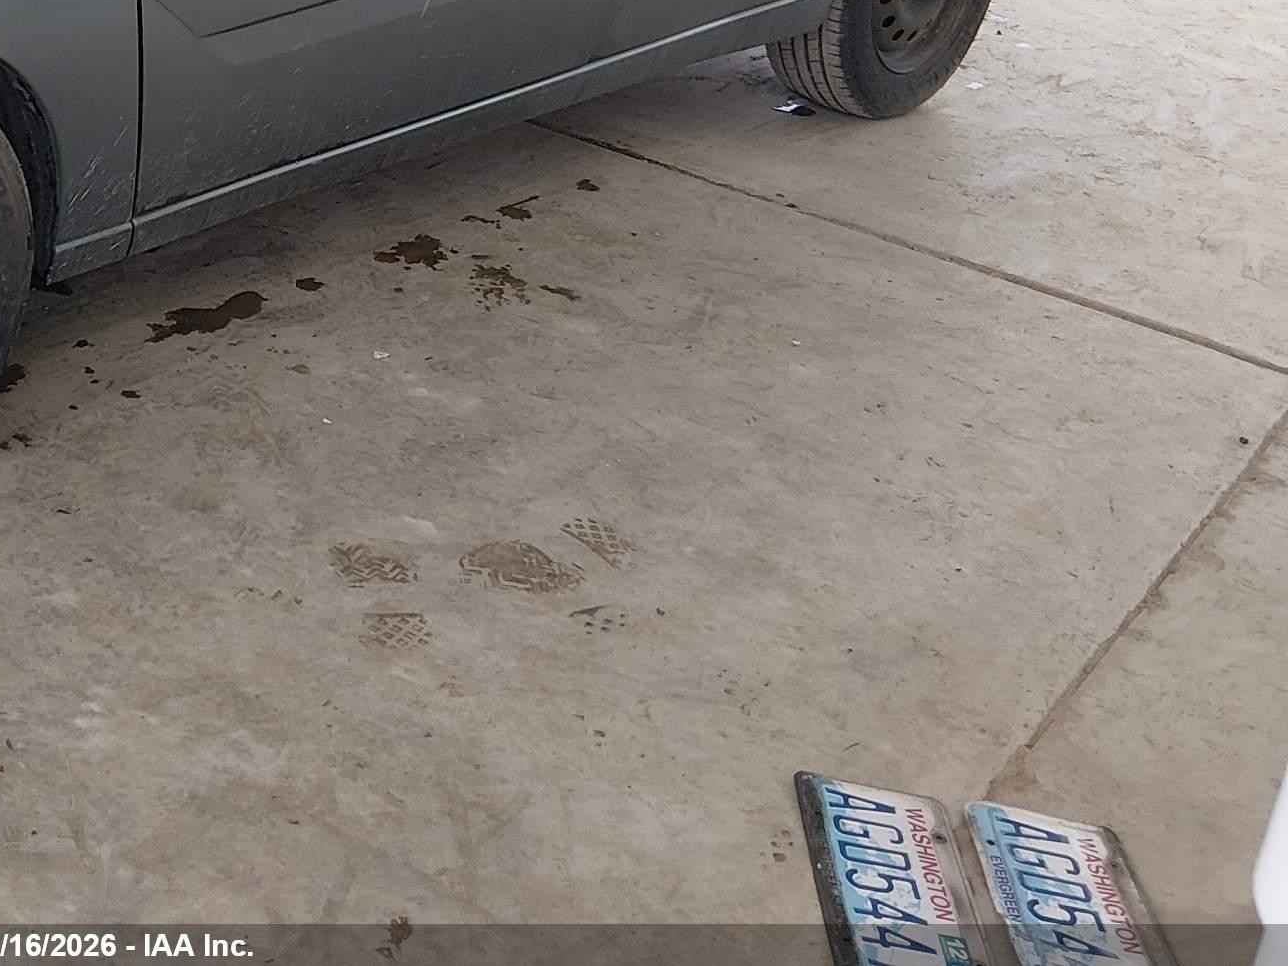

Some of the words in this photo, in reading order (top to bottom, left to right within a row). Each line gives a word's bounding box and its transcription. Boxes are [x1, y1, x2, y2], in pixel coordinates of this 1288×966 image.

[824, 786, 938, 966] AGD544
[904, 808, 955, 922] WASHINGTON
[990, 855, 1022, 923] EVERGREEN
[995, 815, 1121, 966] AGD54
[1077, 837, 1144, 955] WASHINGTON
[946, 939, 969, 961] 12
